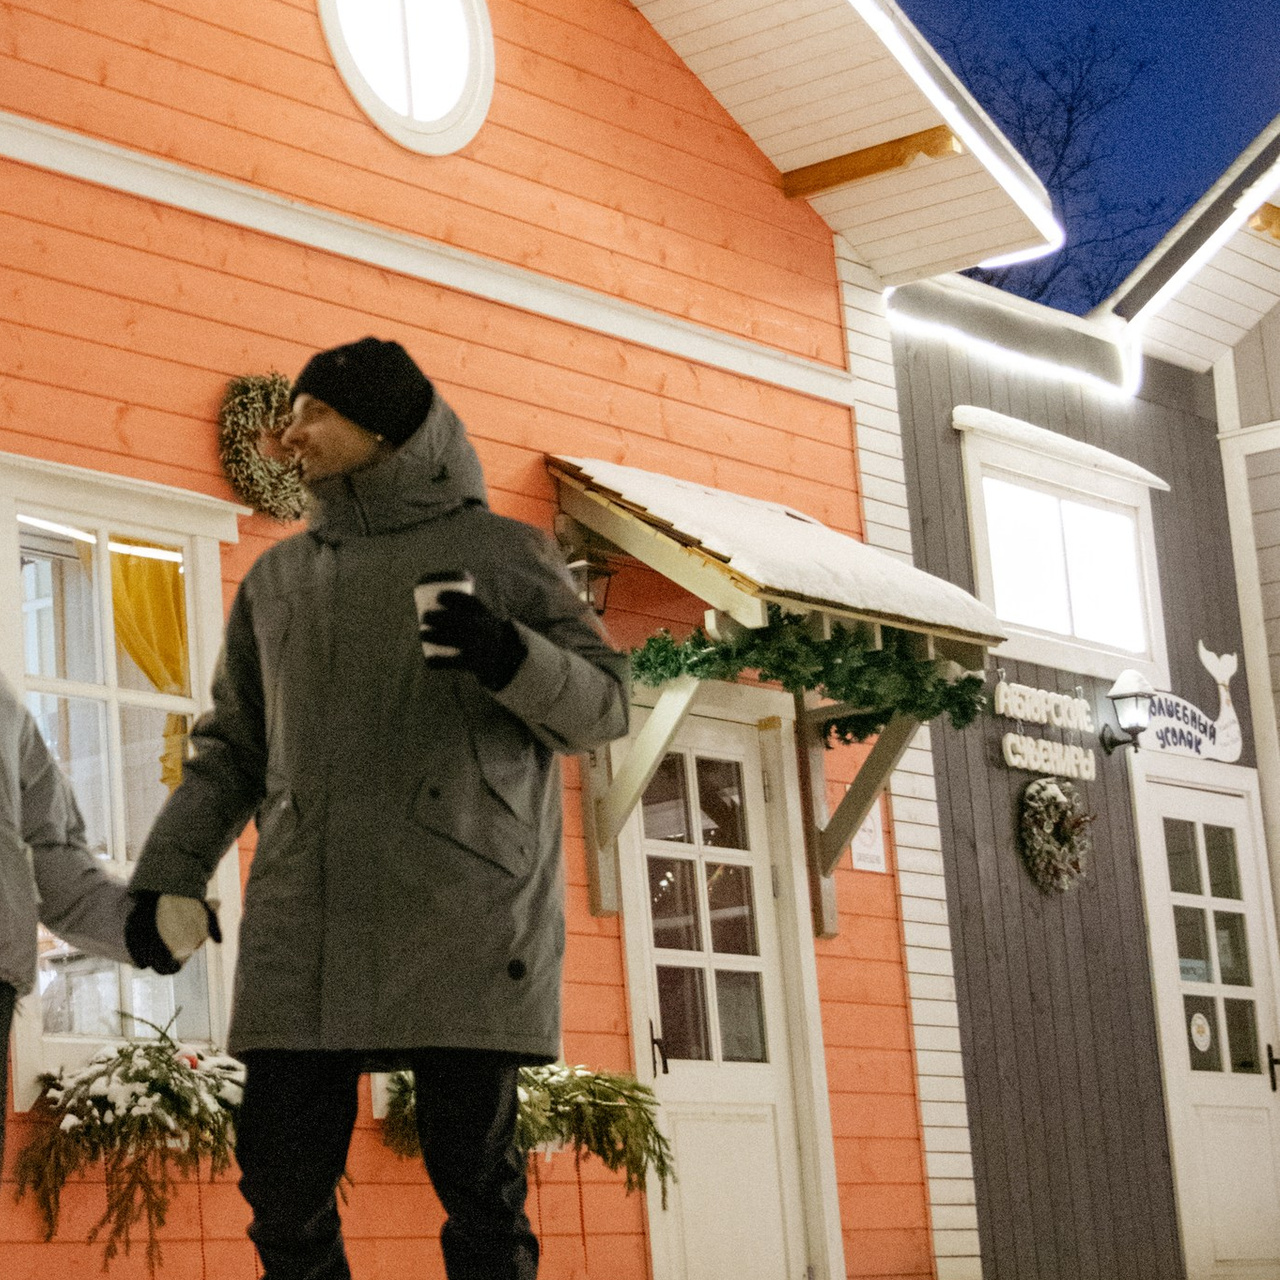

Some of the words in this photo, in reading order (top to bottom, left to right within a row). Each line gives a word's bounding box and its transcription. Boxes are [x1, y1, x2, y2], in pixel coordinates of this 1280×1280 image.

[1149, 697, 1216, 745] ОЛШЕБНЫЙ
[1156, 726, 1202, 755] УГОЛОК
[1002, 732, 1095, 781] СУВЕНИРЫ
